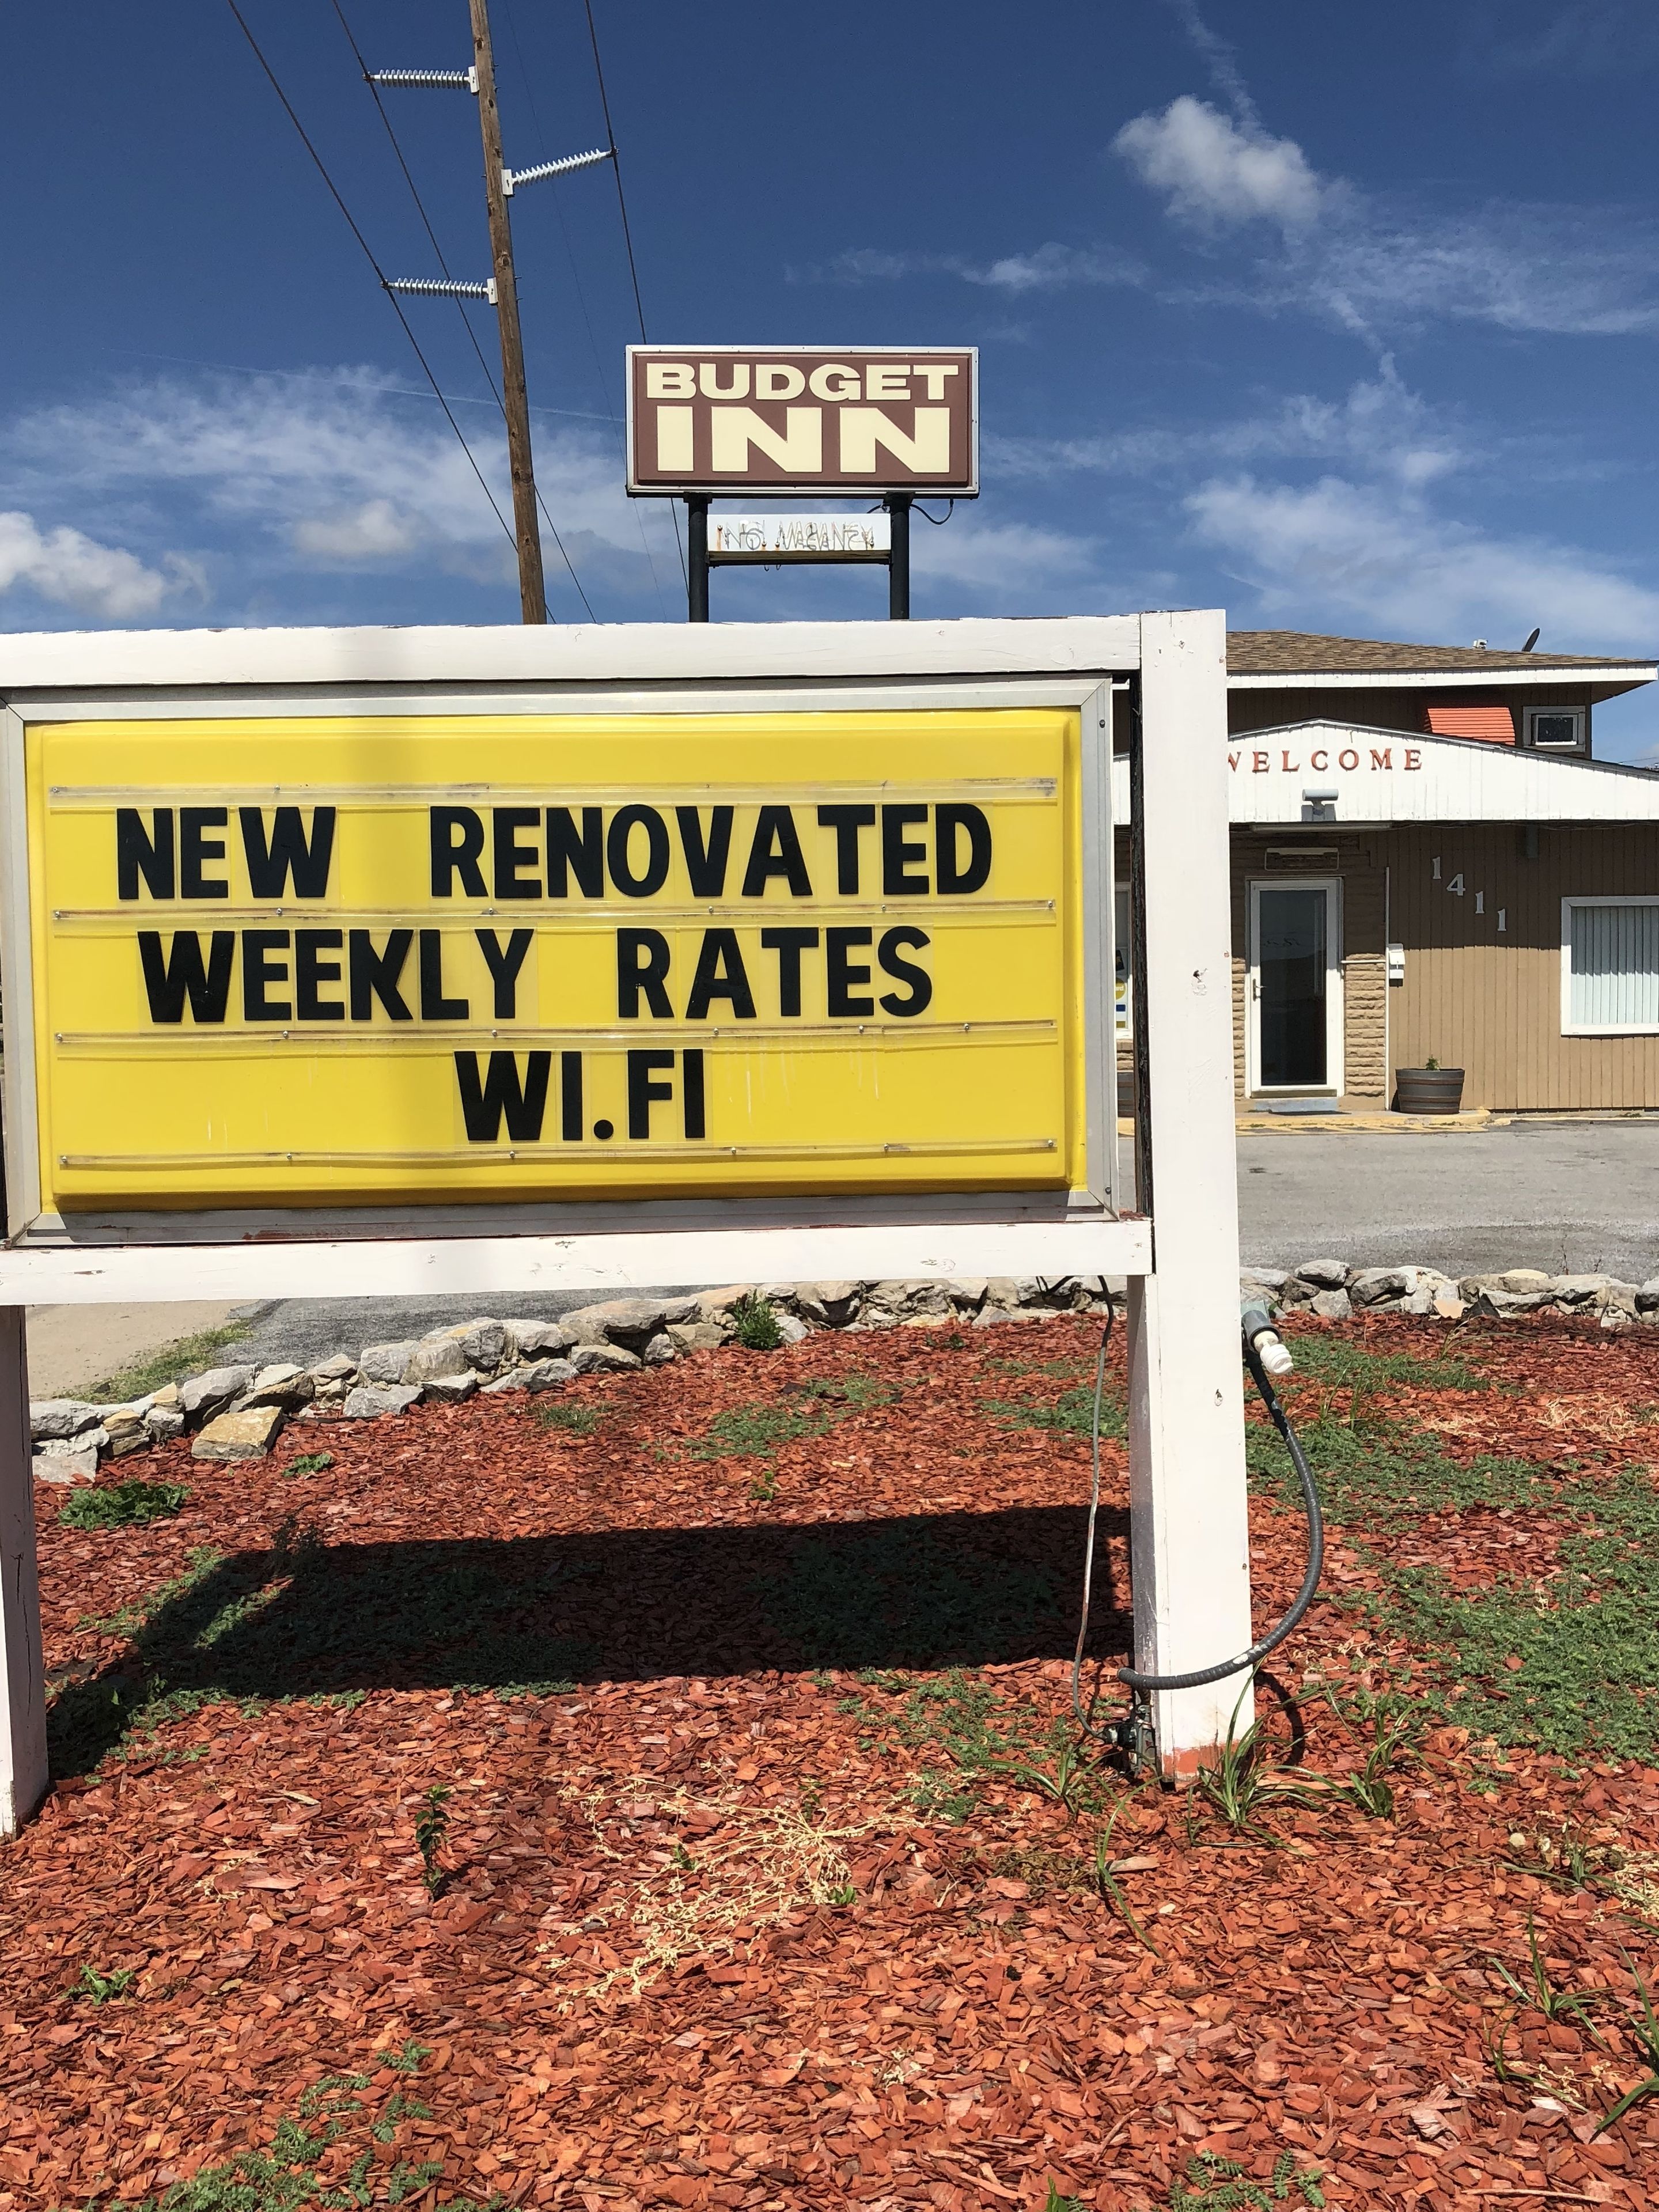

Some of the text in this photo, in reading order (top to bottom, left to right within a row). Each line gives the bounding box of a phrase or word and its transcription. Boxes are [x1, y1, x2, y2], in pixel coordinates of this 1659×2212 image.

[646, 362, 959, 402] BUDGET
[657, 405, 950, 474] INN
[116, 802, 993, 900] NEW RENOVATED
[1432, 856, 1507, 931] 1411
[137, 925, 933, 1024] WEEKLY RATES
[453, 1048, 707, 1142] WI.FI
